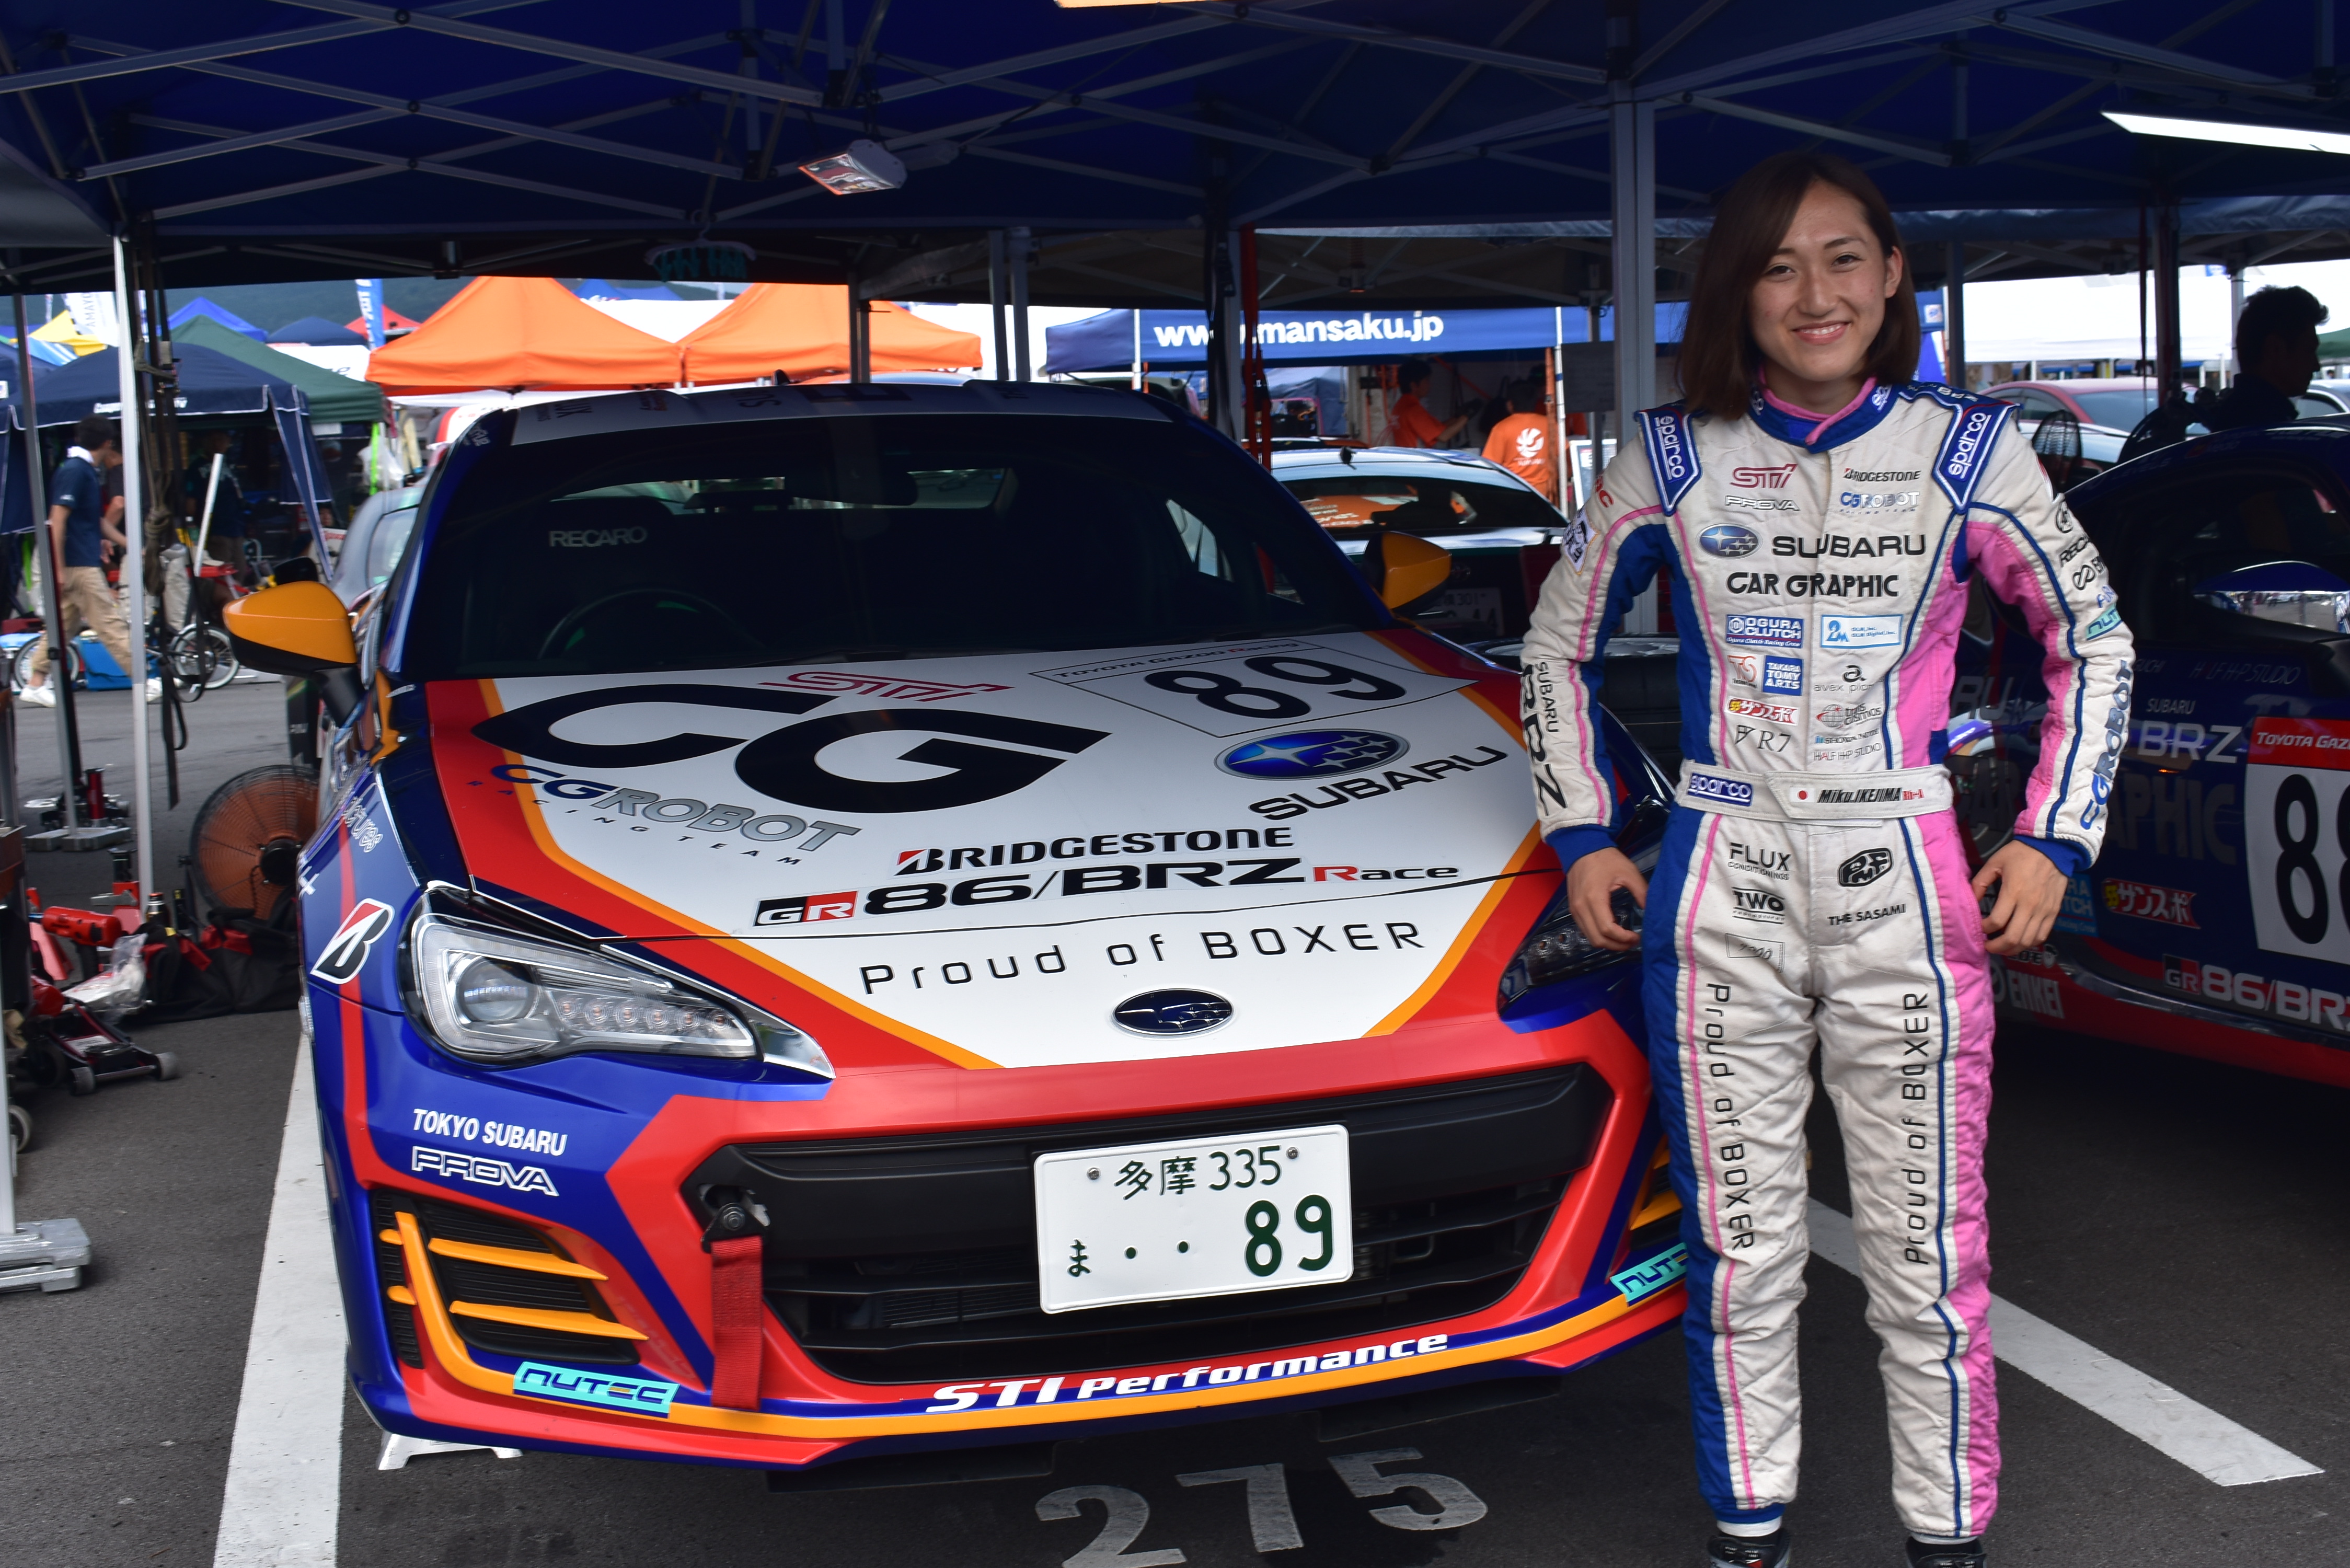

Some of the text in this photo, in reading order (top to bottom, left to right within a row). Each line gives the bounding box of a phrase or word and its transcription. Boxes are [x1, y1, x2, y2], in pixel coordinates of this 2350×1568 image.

[1154, 311, 1444, 347] ww.mansaku.jp
[1654, 415, 1685, 480] sparco
[1948, 412, 1992, 479] sparco
[1842, 467, 1922, 482] BRIDGESTONE
[1725, 495, 1801, 512] PROVA
[549, 526, 648, 548] RECARO
[1771, 533, 1927, 558] SUBARU
[1726, 572, 1900, 598] CAR GRAPHIC
[1744, 627, 1802, 639] CLUTCH
[1745, 617, 1802, 630] OGURA
[1052, 642, 1300, 678] TOYOTA GAZOO Racing
[1766, 662, 1801, 673] TAKARA
[1766, 670, 1801, 681] TOMY
[1144, 655, 1408, 719] 89
[1535, 661, 1560, 733] SUBARU
[2145, 697, 2197, 716] SUBARU
[2137, 719, 2242, 764] BRZ
[2256, 731, 2350, 752] TOYOTA GAZ
[1248, 745, 1509, 822] SUBARU
[1687, 774, 1752, 803] sparco
[466, 779, 803, 867] RACING TEAM
[894, 826, 1296, 877] BRIDGESTONE
[1729, 842, 1792, 871] FLUX
[862, 857, 1309, 915] 86/BRZ
[1312, 864, 1461, 883] Race
[1732, 890, 1785, 912] TWO
[1827, 903, 1907, 926] THE SASAMI
[859, 920, 1426, 995] Proud of BOXER
[413, 1108, 568, 1157] TOKYO SUBARU
[1704, 982, 1755, 1252] Proud of BOXER
[1900, 992, 1931, 1265] Proud of BOXER
[411, 1145, 560, 1197] PROVA
[1113, 1144, 1283, 1201] 多摩 335
[1067, 1239, 1091, 1277] ま
[1618, 1248, 1689, 1294] NUTE
[925, 1333, 1449, 1413] STI Performance
